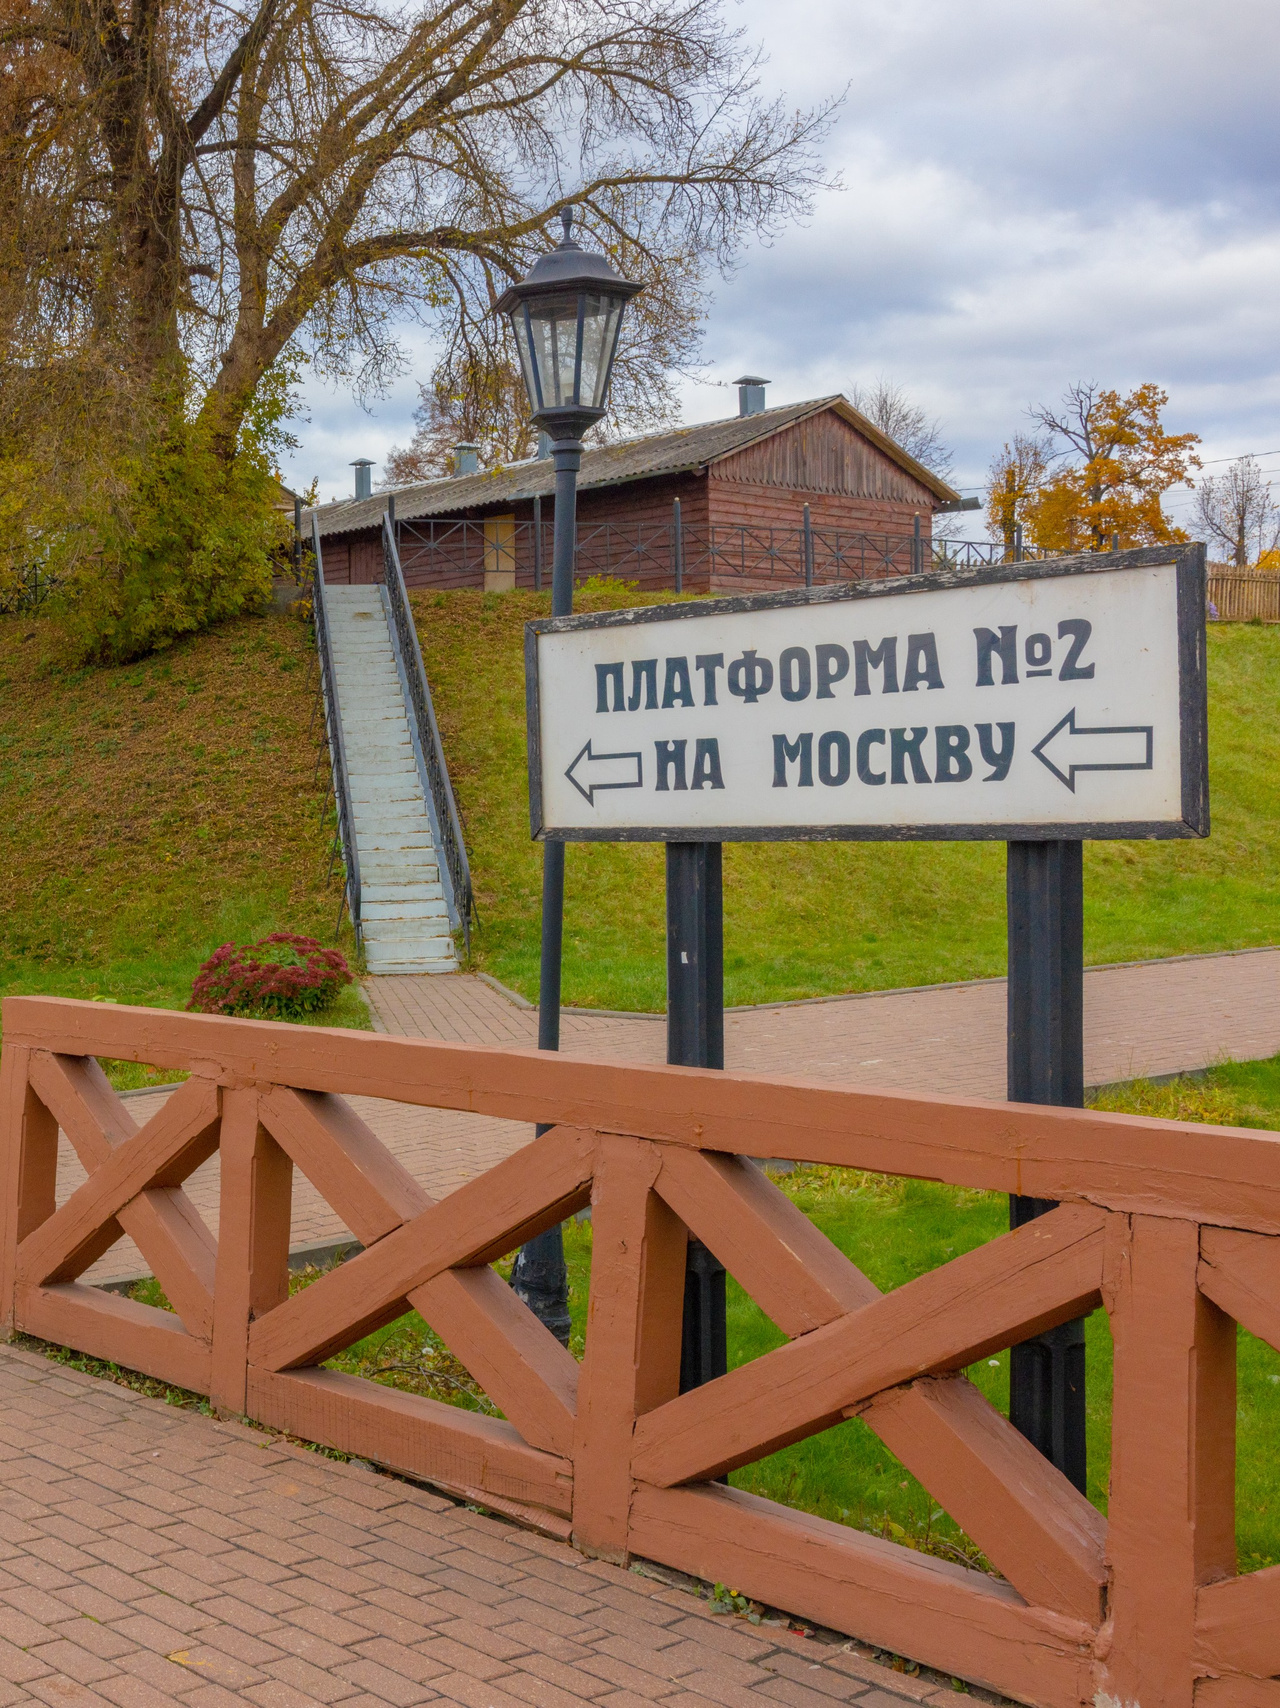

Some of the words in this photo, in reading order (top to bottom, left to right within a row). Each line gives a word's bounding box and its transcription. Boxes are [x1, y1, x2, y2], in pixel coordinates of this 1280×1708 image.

[594, 632, 945, 714] ПЛАТФОРМА
[654, 737, 726, 792] НА
[772, 721, 1016, 788] МОСКВУ
